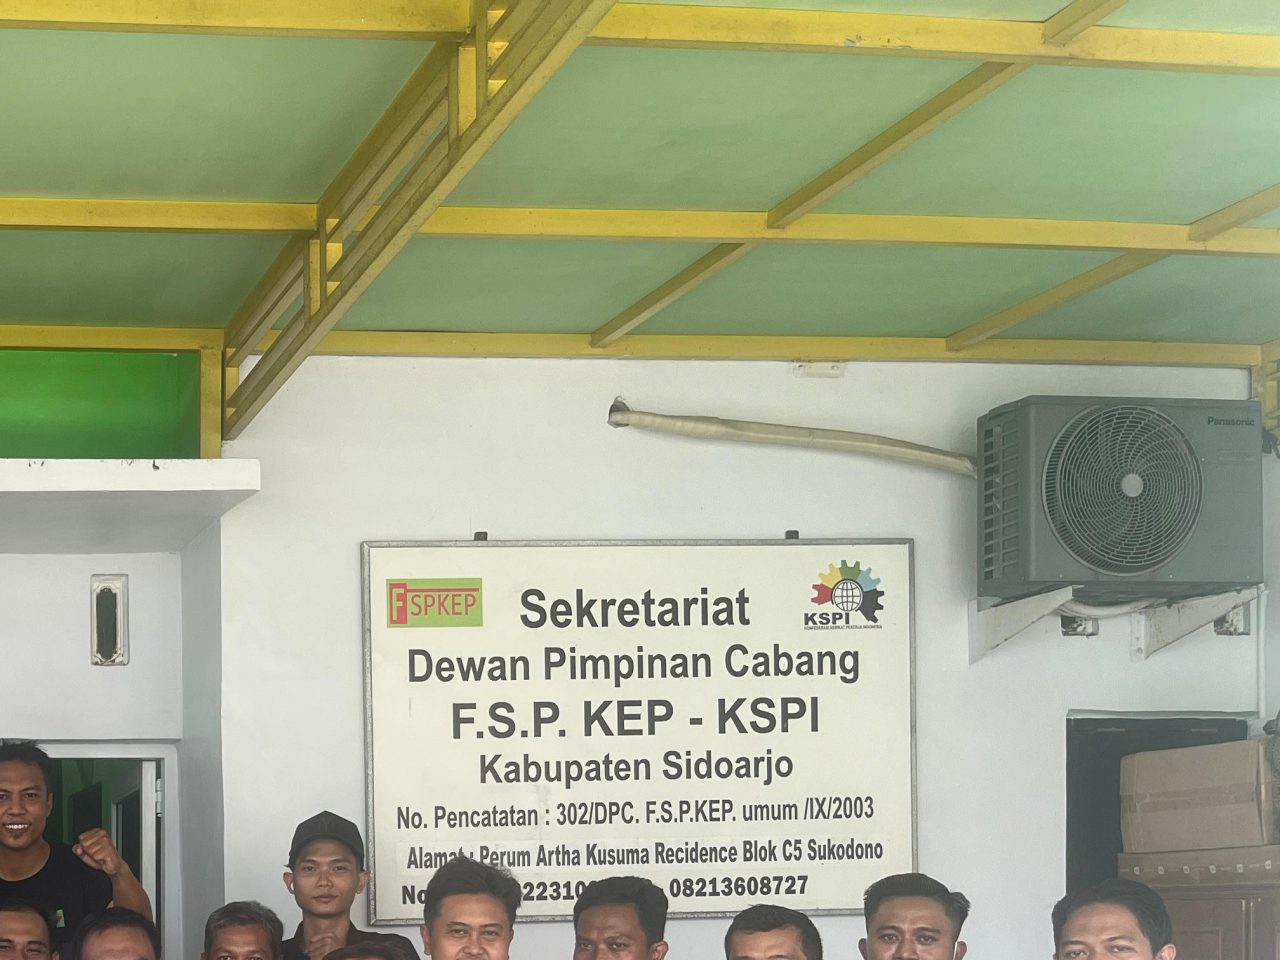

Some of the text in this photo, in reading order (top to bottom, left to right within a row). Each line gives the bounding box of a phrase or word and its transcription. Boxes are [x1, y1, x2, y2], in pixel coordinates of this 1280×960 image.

[389, 583, 478, 625] FSPKEP
[519, 587, 751, 629] Sekretariat
[803, 612, 850, 626] KSPI
[408, 643, 860, 688] Dewan Pimpinan Cabang
[452, 696, 819, 740] F.S.P. KEP - KSPI
[479, 748, 794, 790] Kabupaten Sidoarjo
[396, 795, 875, 829] No. Pencatatan : 302/DPC. F.S.P.KEP. umum /IX/2003
[479, 845, 532, 868] Perum
[535, 844, 581, 868] Artha
[586, 843, 650, 867] Kusuma
[654, 841, 738, 865] Recidence
[742, 839, 778, 863] Blok
[782, 838, 803, 862] C5
[807, 838, 884, 862] Sukodono
[522, 881, 587, 901] 22310
[669, 875, 809, 898] 08213608727
